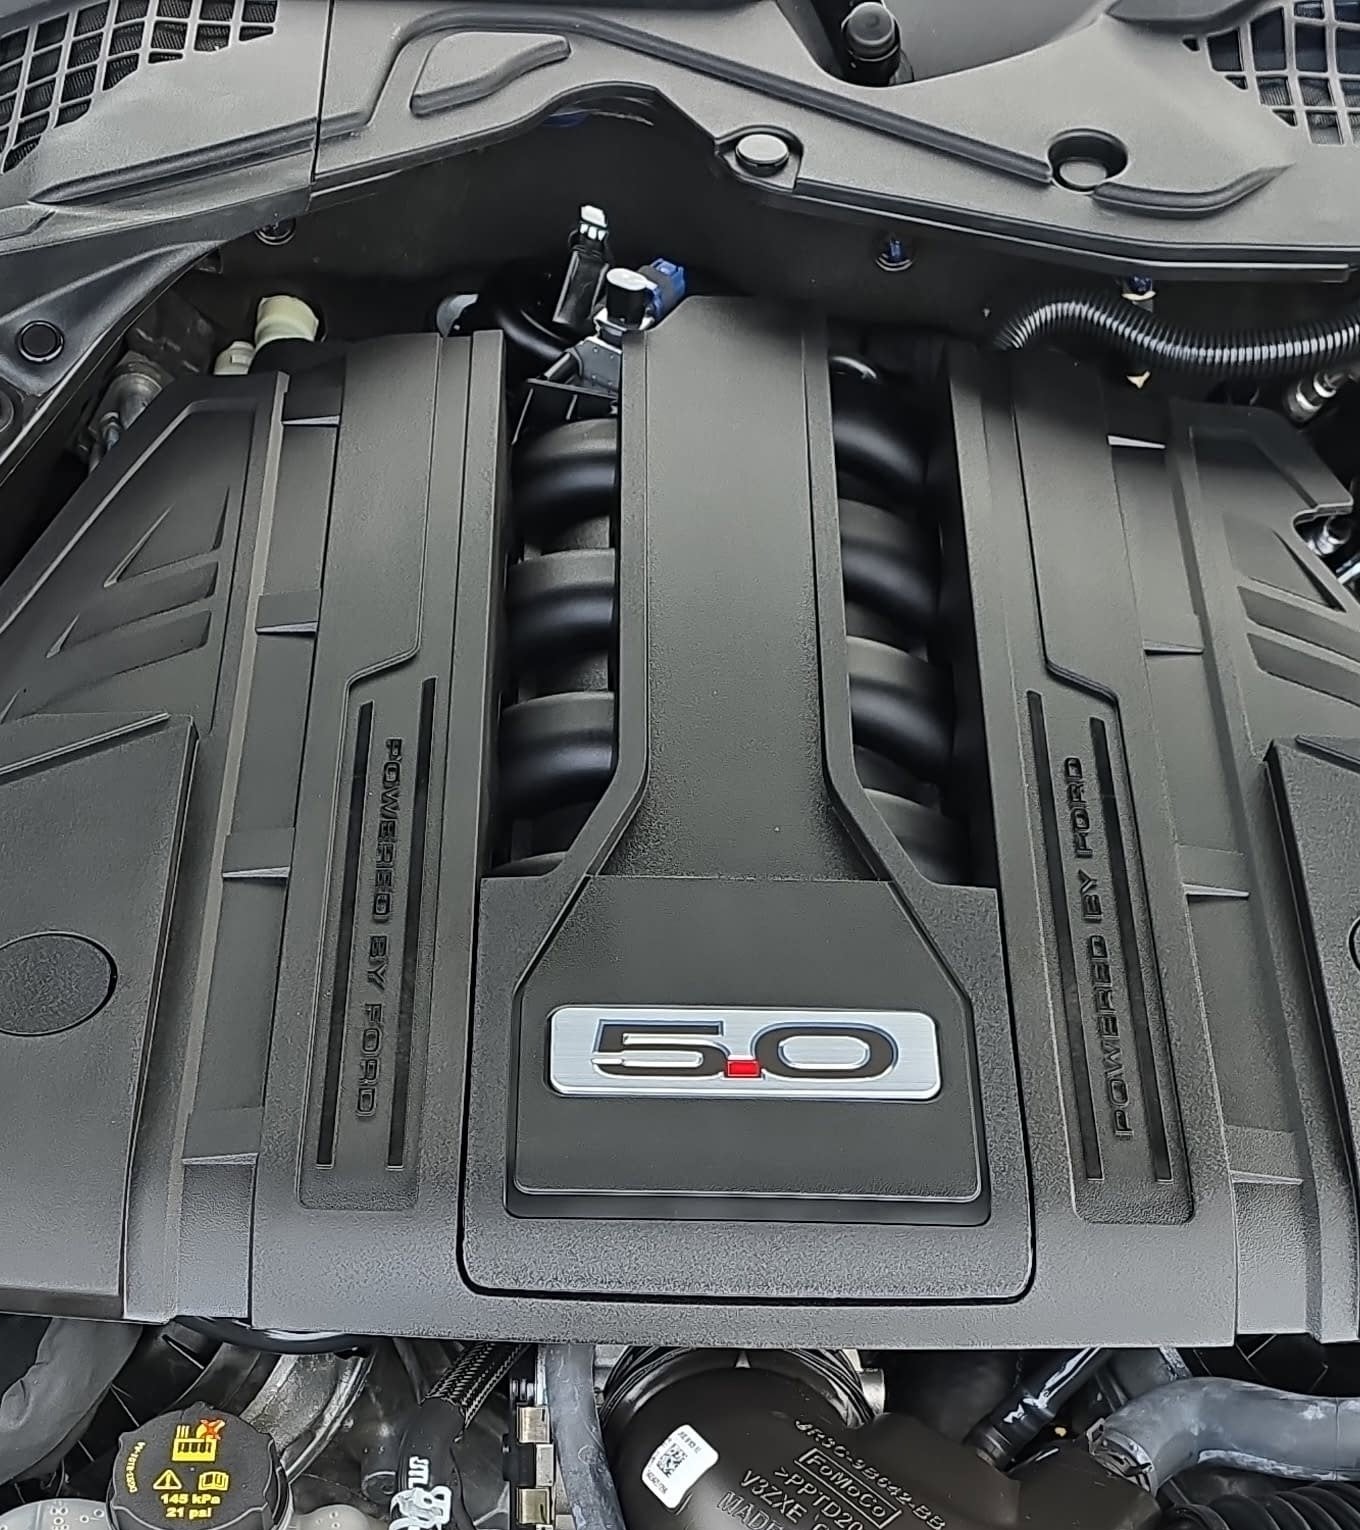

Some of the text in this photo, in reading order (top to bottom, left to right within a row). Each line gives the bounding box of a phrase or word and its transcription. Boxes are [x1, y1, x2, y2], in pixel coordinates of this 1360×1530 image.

[355, 736, 403, 1118] POWERED BY FORD
[1063, 755, 1135, 1141] POWERED BY FORD
[590, 1018, 900, 1081] 5.0
[160, 1493, 221, 1505] 145 kPa
[165, 1506, 213, 1520] 21 psi
[805, 1453, 887, 1519] FoMoCo
